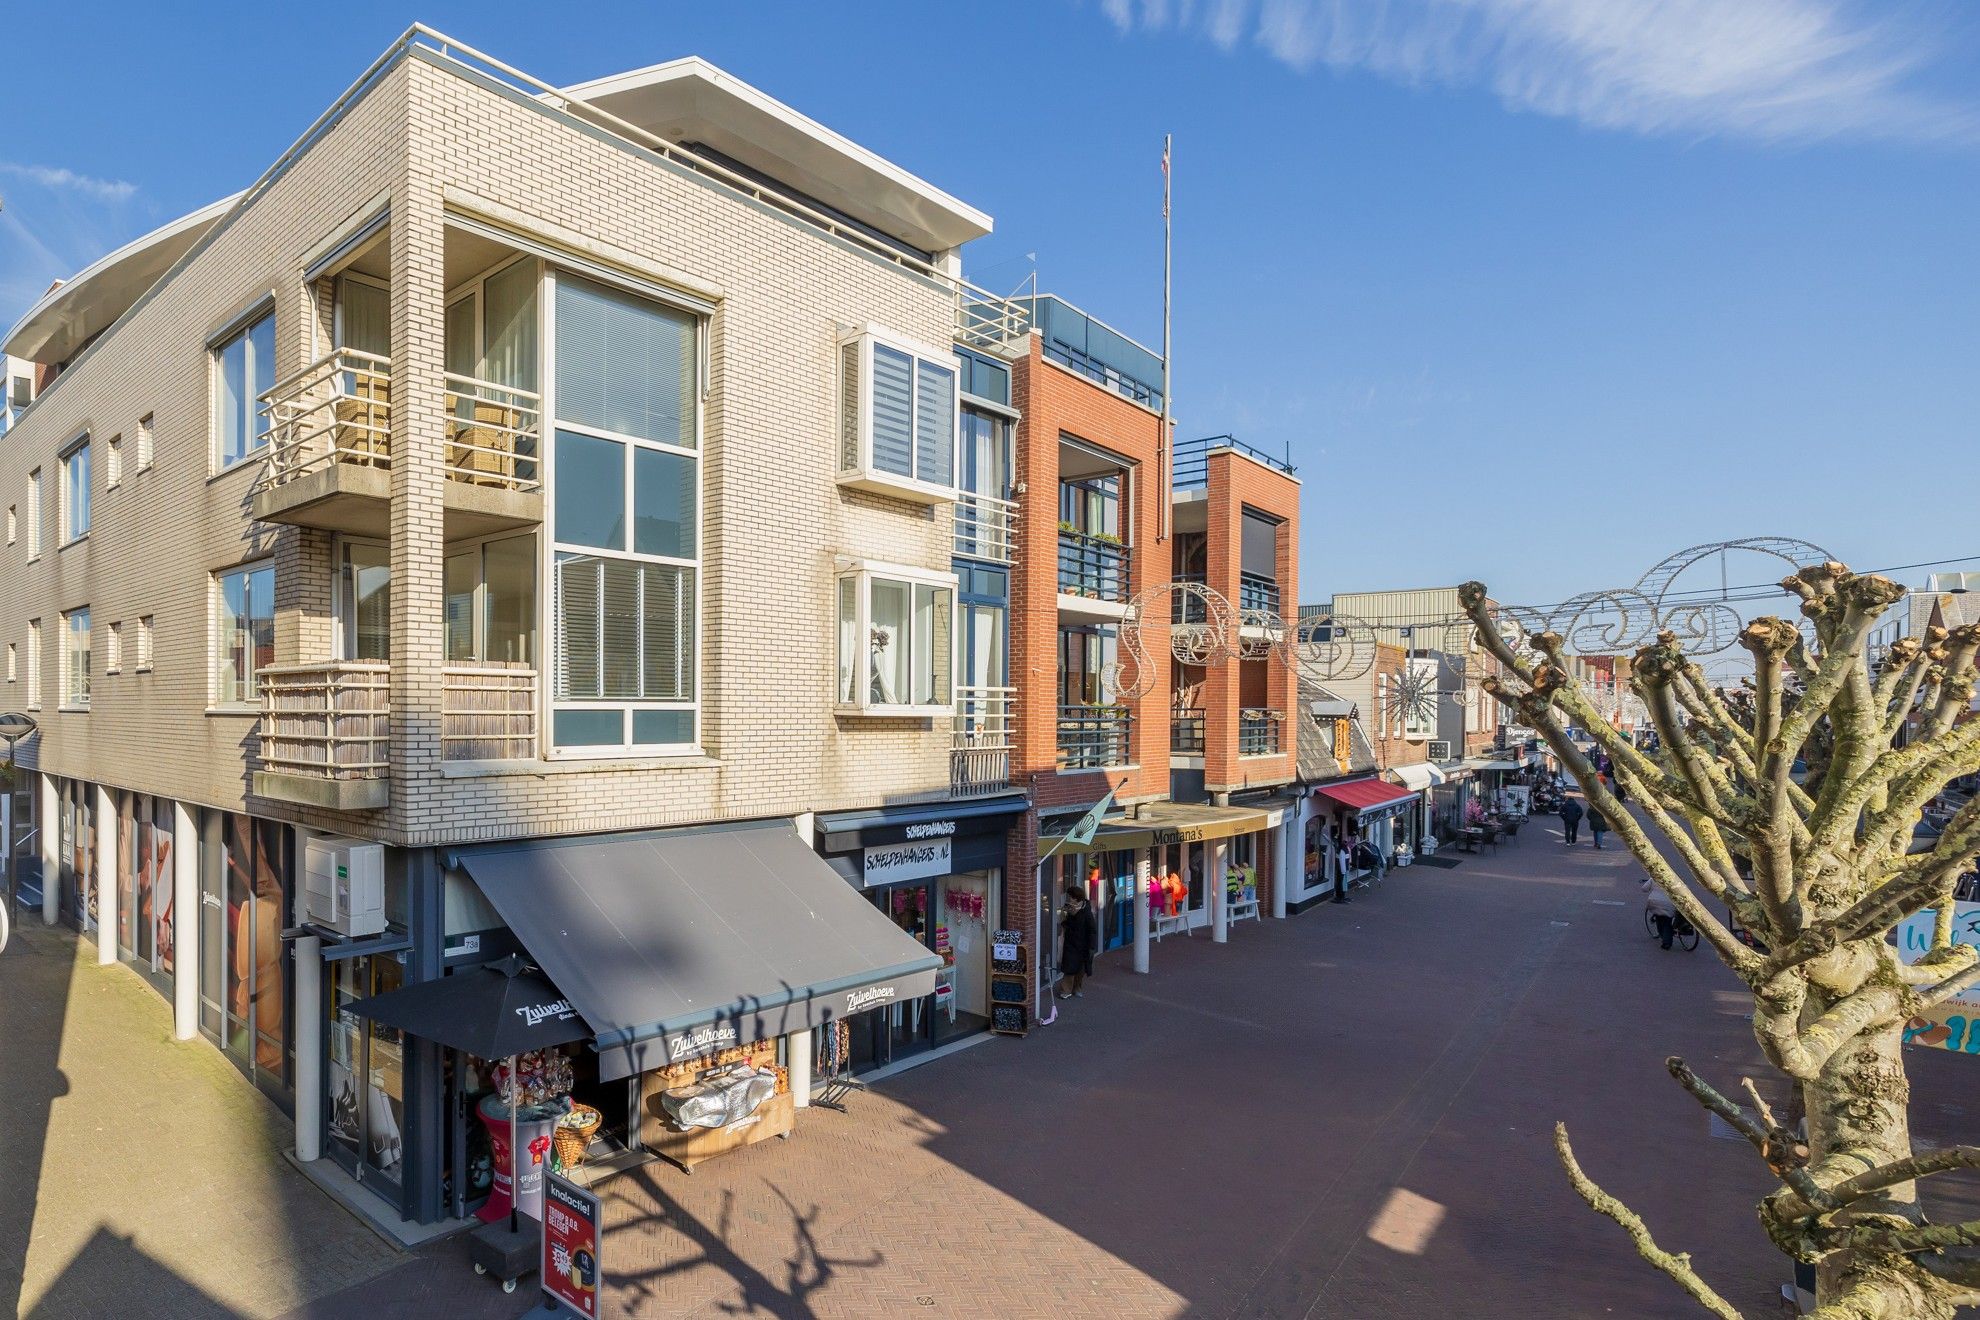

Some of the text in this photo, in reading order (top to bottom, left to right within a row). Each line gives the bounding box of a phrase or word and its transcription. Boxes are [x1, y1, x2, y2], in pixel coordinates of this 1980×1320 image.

[1152, 825, 1203, 845] Montana's
[847, 987, 895, 1013] Zuivelhoeve
[671, 1028, 737, 1061] Zuivelhoeve
[551, 1183, 590, 1216] knalactie!
